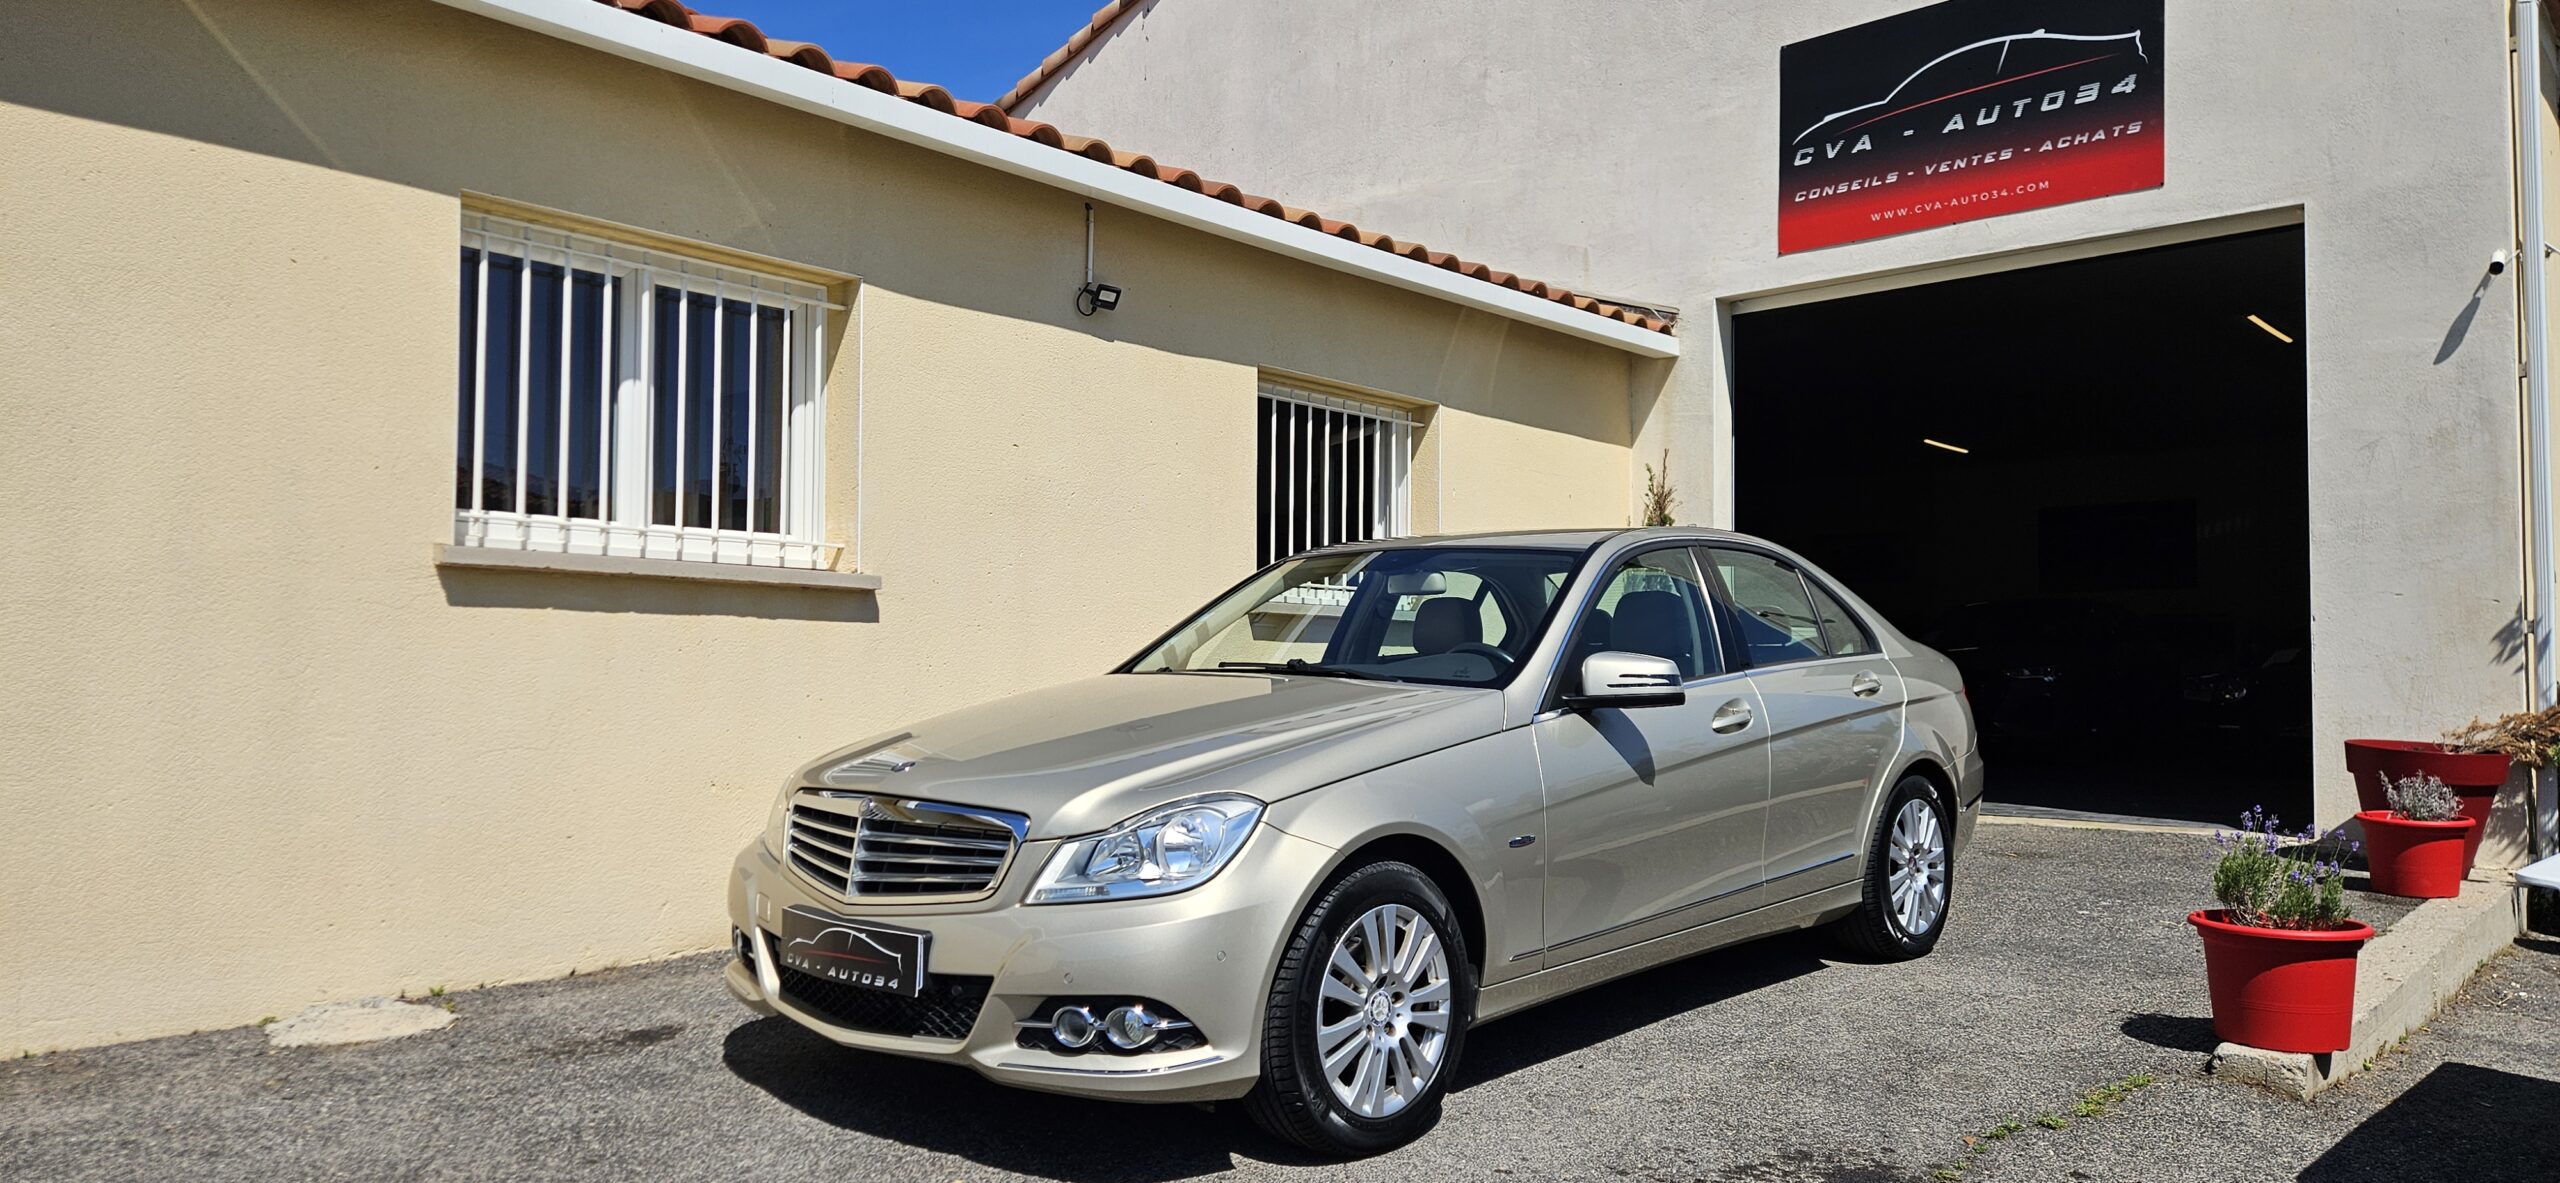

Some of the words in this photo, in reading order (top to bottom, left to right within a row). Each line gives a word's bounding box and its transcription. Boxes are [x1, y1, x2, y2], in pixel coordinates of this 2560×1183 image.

[1793, 134, 1873, 167] CVA
[1903, 128, 1916, 137] -
[1942, 73, 2138, 135] AUTO34
[1794, 171, 1899, 202] CONSEILS
[1925, 147, 2014, 176] VENTES
[2039, 121, 2143, 153] ACHATS
[1870, 180, 2050, 222] WWW.CVA-AUTO34.COM
[787, 953, 809, 970] CVA
[827, 966, 899, 989] AUTO34
